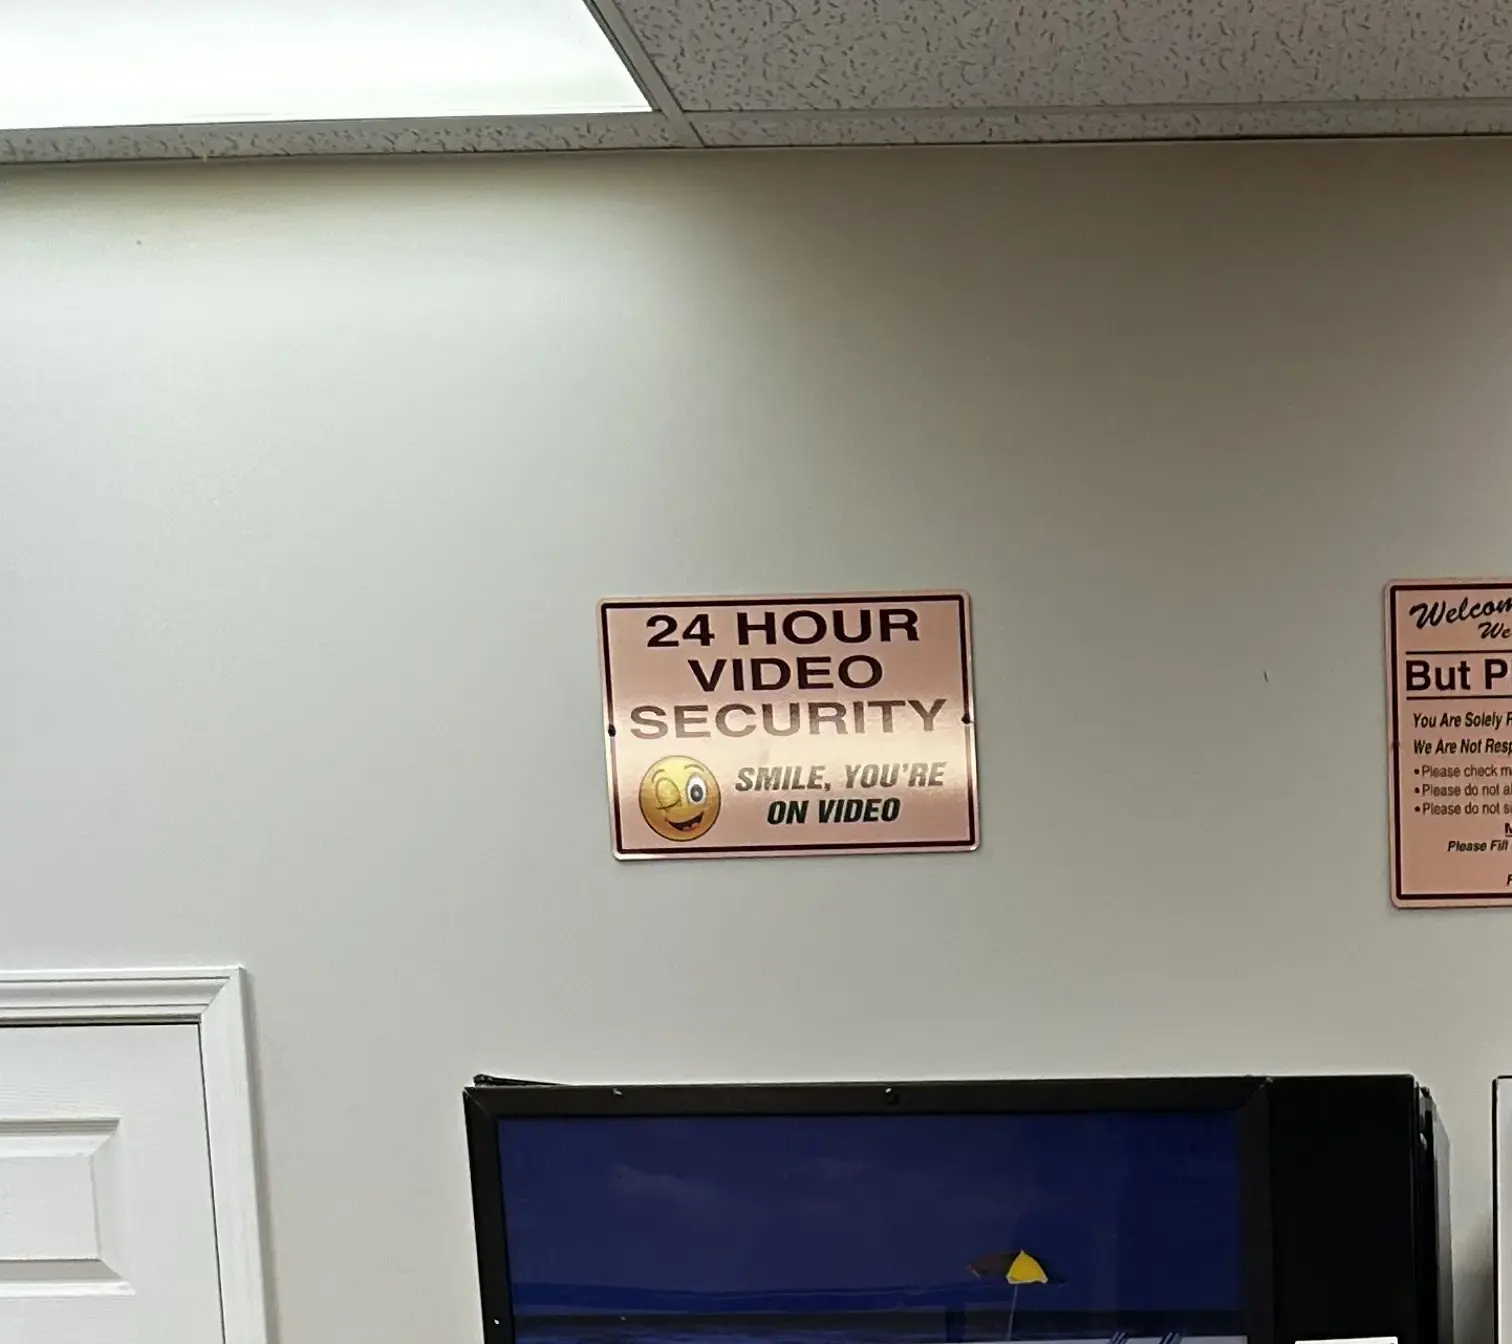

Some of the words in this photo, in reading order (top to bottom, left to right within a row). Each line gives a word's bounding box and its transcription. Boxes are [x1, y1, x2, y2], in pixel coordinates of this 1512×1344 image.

[646, 614, 714, 646] 24
[737, 608, 918, 646] HOUR
[1478, 622, 1512, 639] We
[688, 655, 882, 692] VIDEO
[1406, 660, 1471, 691] But
[630, 699, 946, 739] SECURITY
[1413, 712, 1436, 728] You
[1440, 712, 1461, 727] Are
[1465, 711, 1502, 730] Solely
[1413, 739, 1432, 754] We
[1435, 739, 1456, 754] Are
[1460, 738, 1482, 754] Not
[735, 765, 830, 792] SMILE,
[845, 762, 946, 788] YOU'RE
[1422, 764, 1461, 778] Please
[1464, 764, 1497, 777] check
[1422, 784, 1461, 796] Please
[1464, 784, 1478, 796] do
[1482, 784, 1500, 796] not
[767, 800, 808, 824] ON
[819, 797, 900, 823] VIDEO
[1422, 802, 1461, 815] Please
[1465, 802, 1479, 814] do
[1482, 802, 1500, 814] not
[1448, 840, 1487, 852] Please
[1490, 840, 1508, 850] Fill
